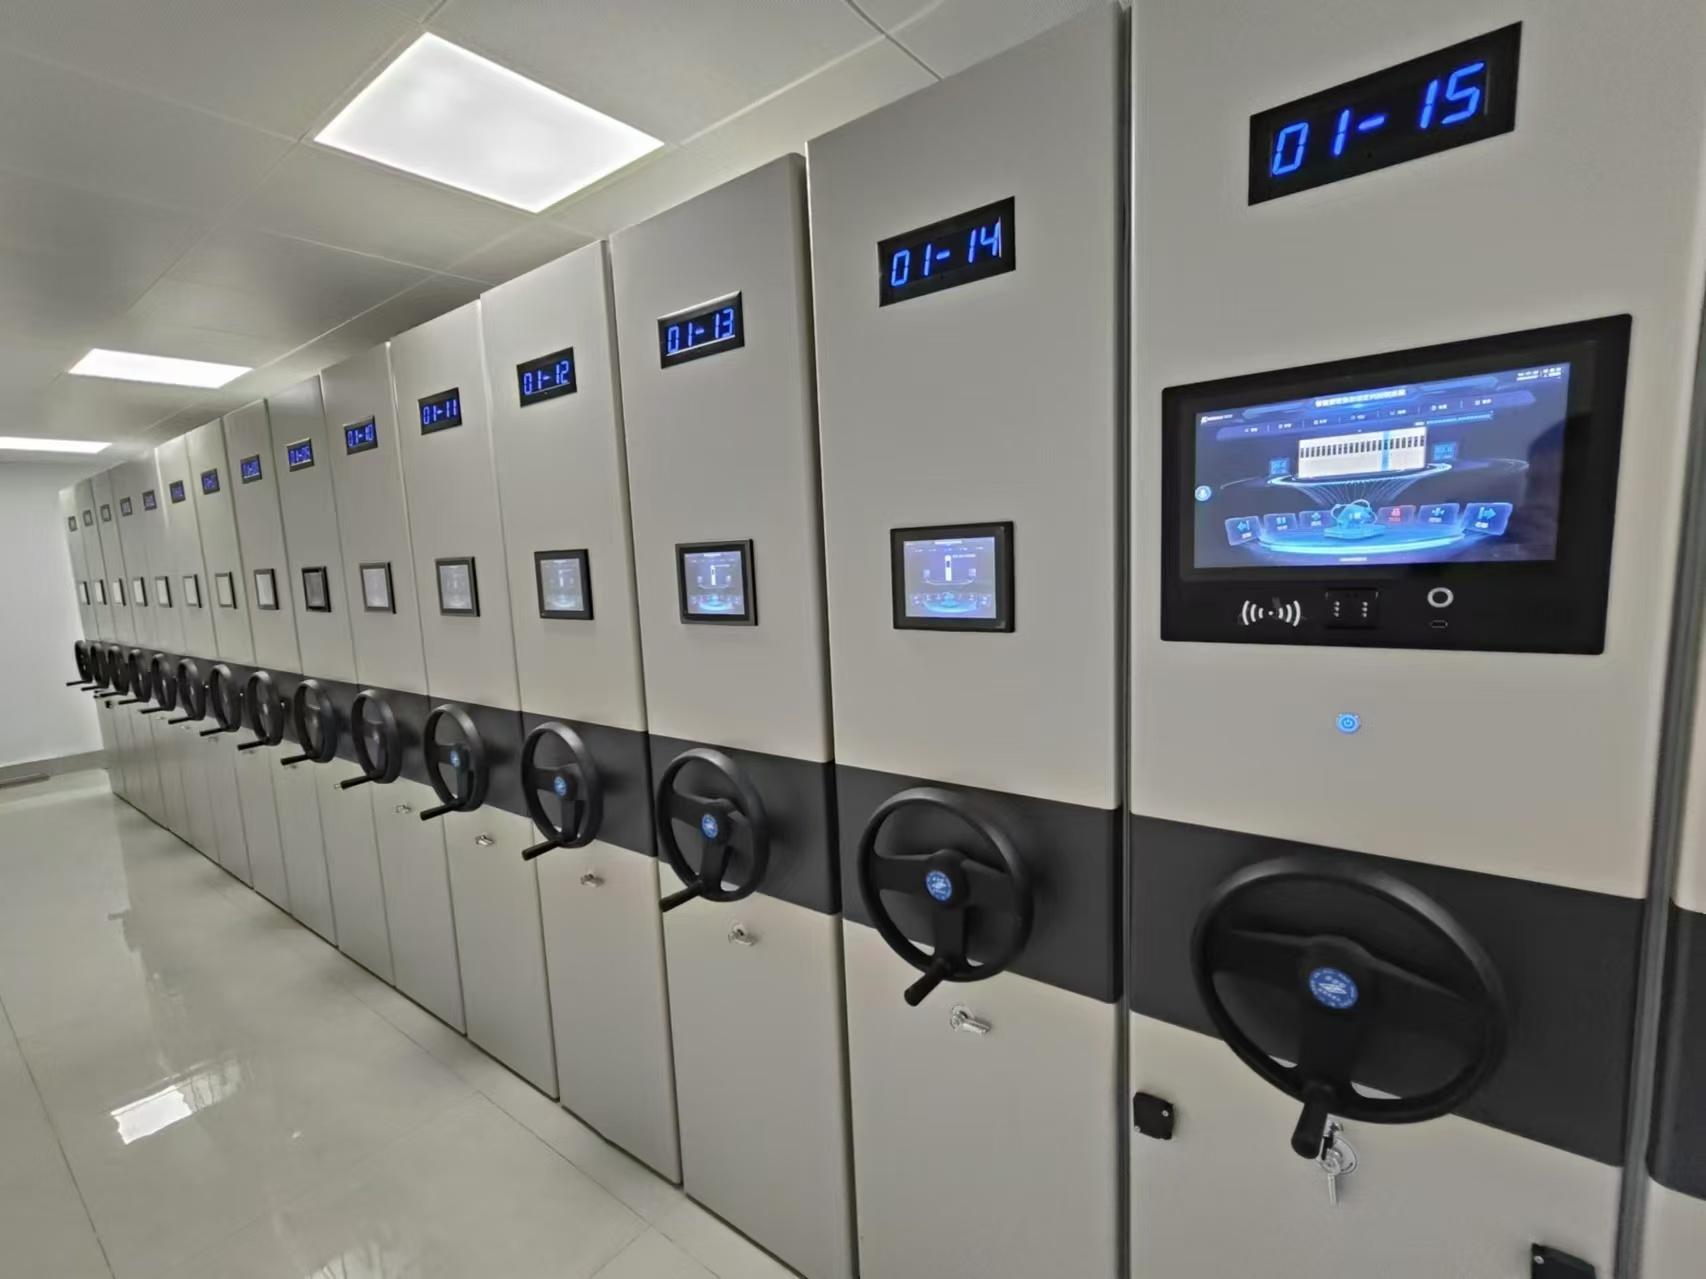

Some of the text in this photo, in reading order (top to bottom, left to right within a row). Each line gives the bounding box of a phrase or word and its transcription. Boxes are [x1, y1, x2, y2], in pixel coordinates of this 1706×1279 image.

[1271, 61, 1485, 176] 01-15
[891, 220, 1001, 287] 01-14
[667, 306, 735, 354] 01-13
[523, 360, 568, 394] 01-12
[423, 399, 457, 424] 01-11
